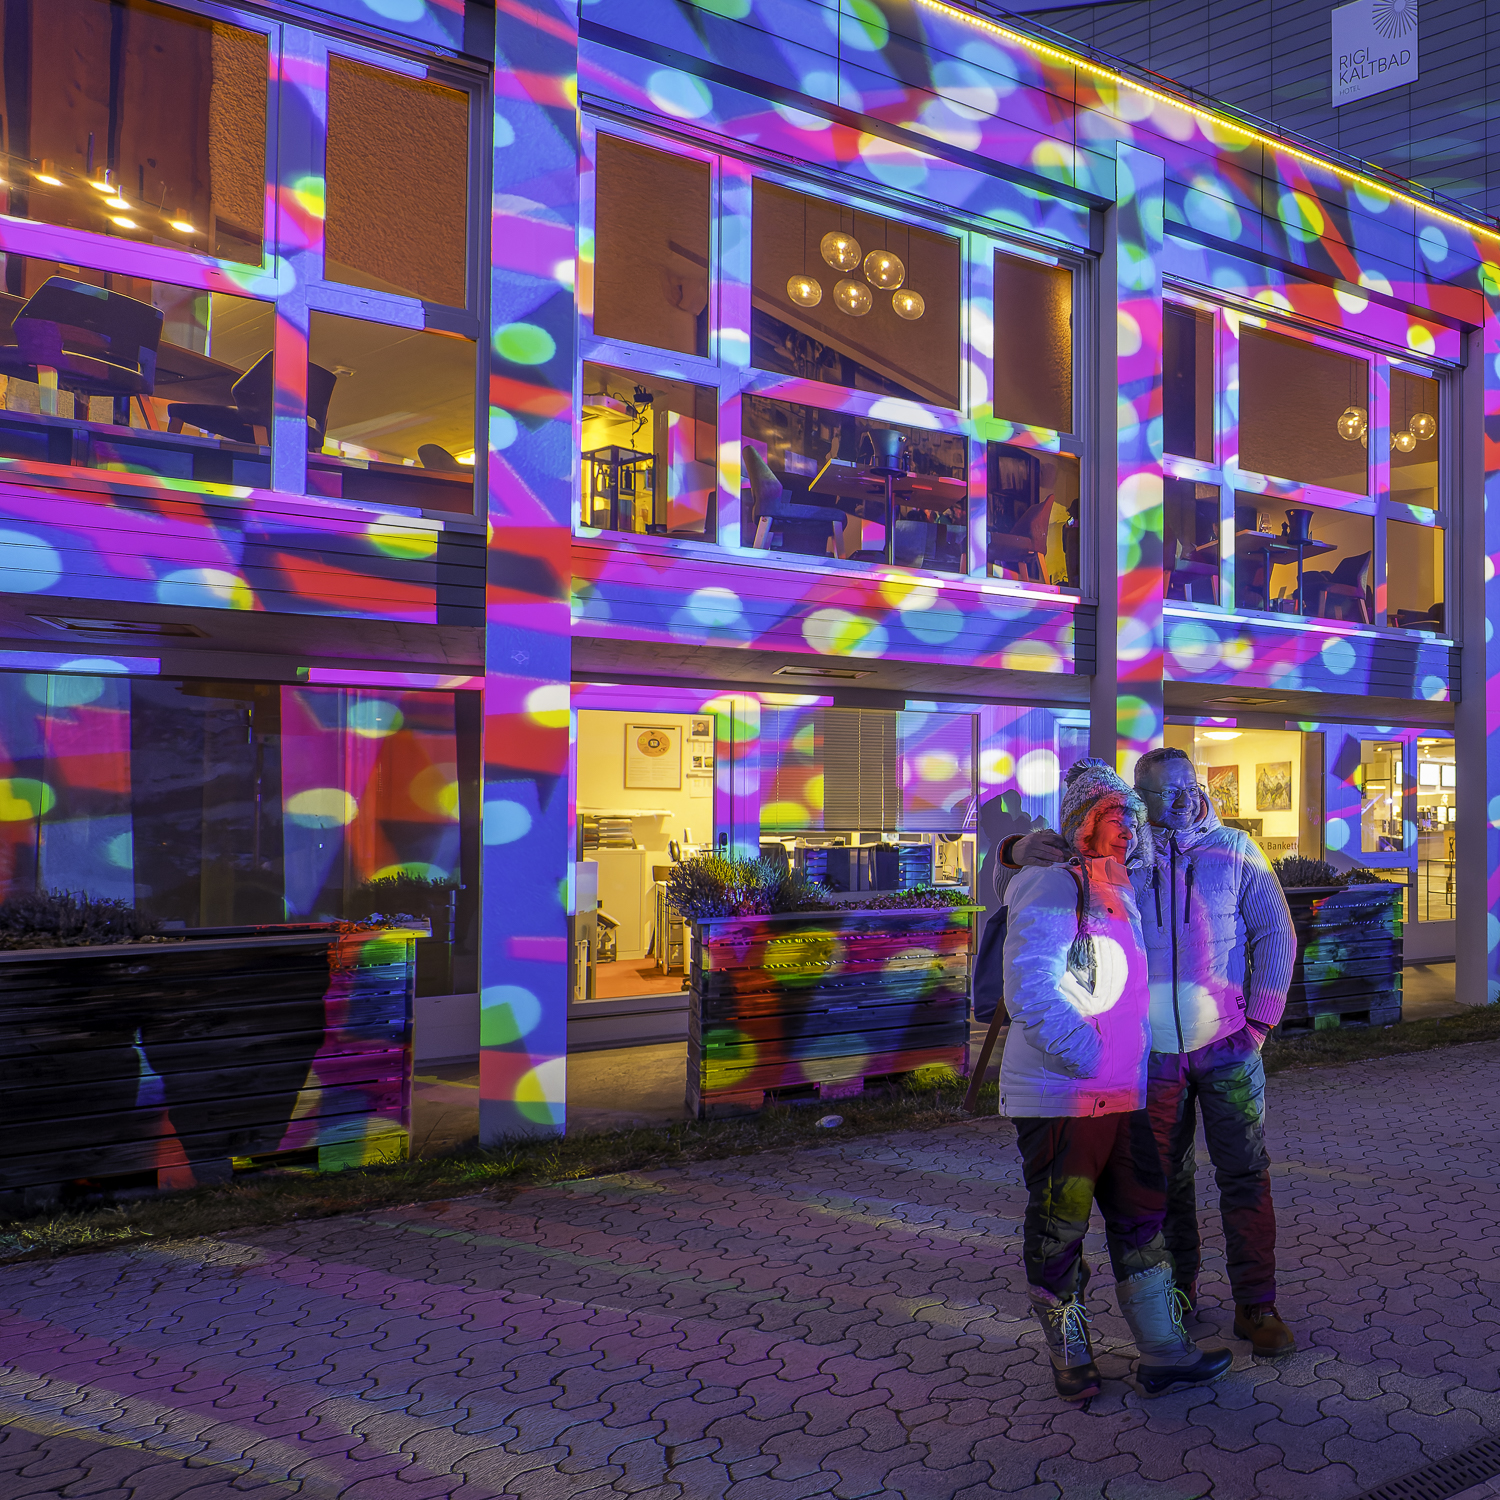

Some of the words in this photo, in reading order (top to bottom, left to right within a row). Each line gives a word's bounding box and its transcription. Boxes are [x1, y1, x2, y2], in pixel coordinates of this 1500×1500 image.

[1339, 47, 1369, 71] RIGI
[1339, 50, 1411, 86] KALTBAD
[1339, 85, 1360, 96] HOTEL
[1259, 842, 1265, 850] &
[1267, 841, 1299, 850] Bankett
